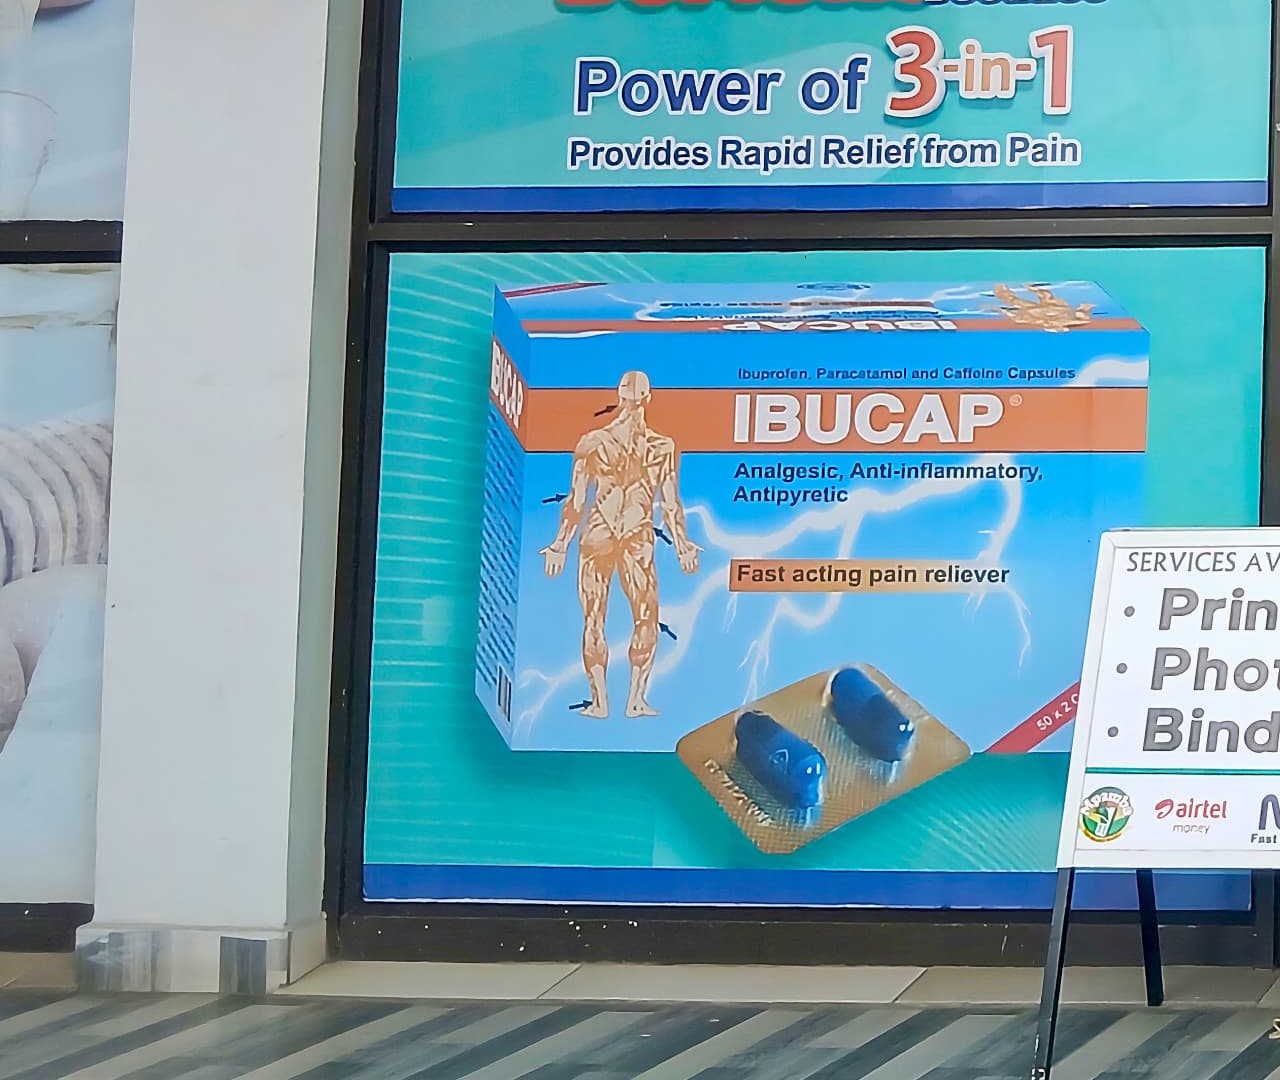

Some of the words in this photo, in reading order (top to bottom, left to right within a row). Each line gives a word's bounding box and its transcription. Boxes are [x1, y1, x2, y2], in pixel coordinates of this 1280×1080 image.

[577, 60, 782, 113] Power
[801, 57, 869, 112] of
[887, 28, 1072, 112] 3-in-1
[569, 140, 709, 169] Provides
[720, 138, 812, 174] Rapid
[823, 137, 920, 168] Relief
[923, 136, 998, 165] from
[1008, 134, 1079, 164] Pain
[816, 365, 908, 381] Paracetamol
[912, 365, 939, 380] and
[942, 364, 1004, 381] Caffeine
[1007, 364, 1077, 383] Capsules
[733, 392, 1005, 445] IBUCAP
[733, 461, 844, 483] Analgesic,
[849, 461, 1043, 483] Anti-inflammatory,
[733, 485, 849, 506] Antipyretic
[1127, 551, 1237, 573] SERVICES
[736, 564, 786, 583] Fast
[792, 563, 862, 586] acting
[869, 564, 918, 586] pain
[924, 563, 1011, 584] reliever
[1036, 715, 1053, 731] 50
[1061, 701, 1073, 712] 2
[1175, 797, 1228, 819] airtel
[1172, 823, 1211, 835] money
[1250, 834, 1278, 845] Fast
